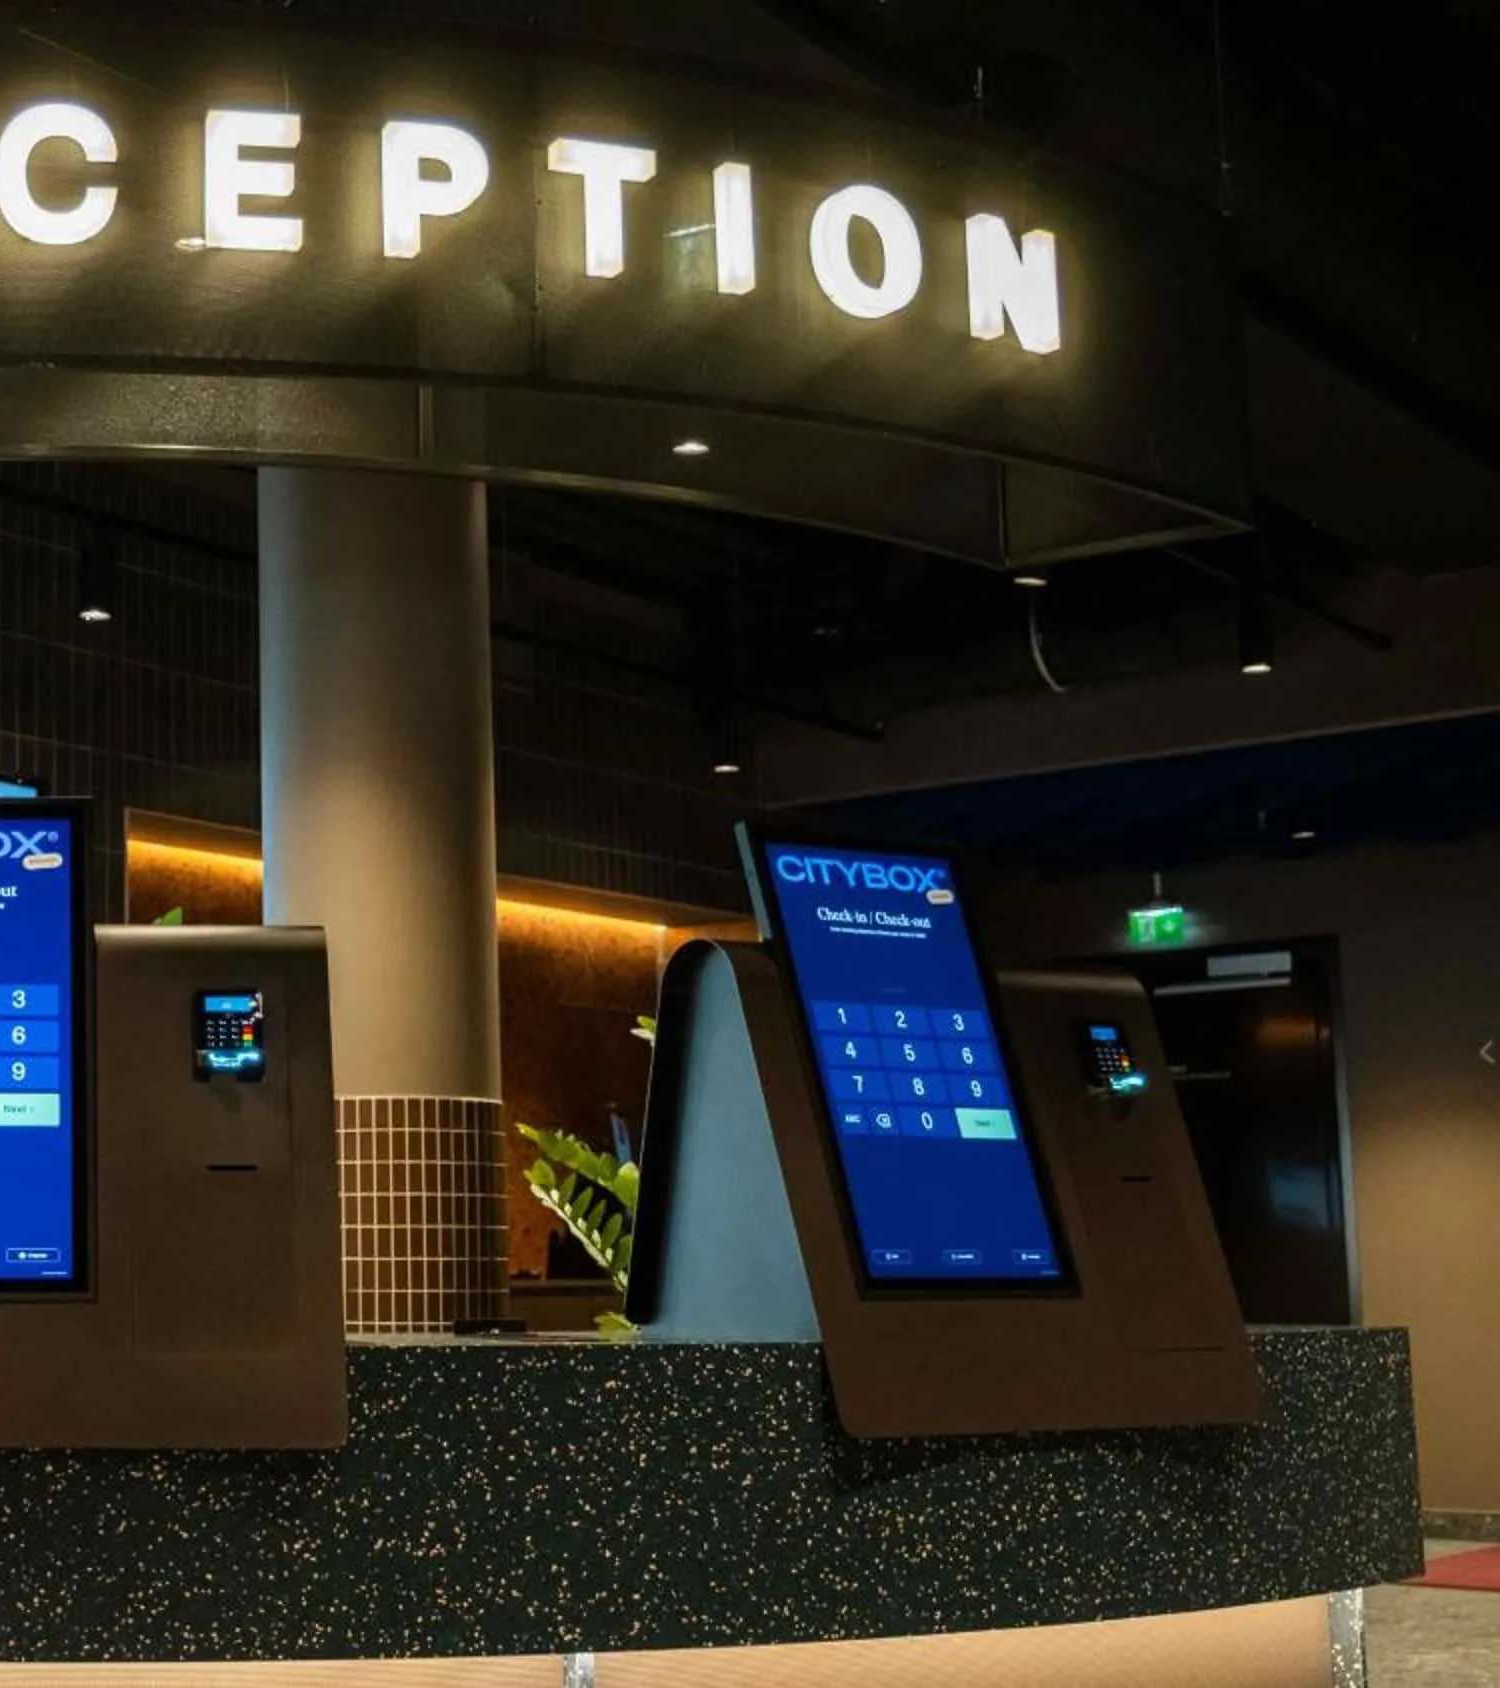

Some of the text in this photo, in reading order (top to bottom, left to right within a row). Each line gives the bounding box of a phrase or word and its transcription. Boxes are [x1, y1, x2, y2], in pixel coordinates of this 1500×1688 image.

[12, 989, 26, 1009] 3
[837, 1007, 965, 1031] 1 2 3
[11, 1025, 27, 1045] 6
[845, 1041, 974, 1065] 4 5 6
[11, 1061, 26, 1081] 9
